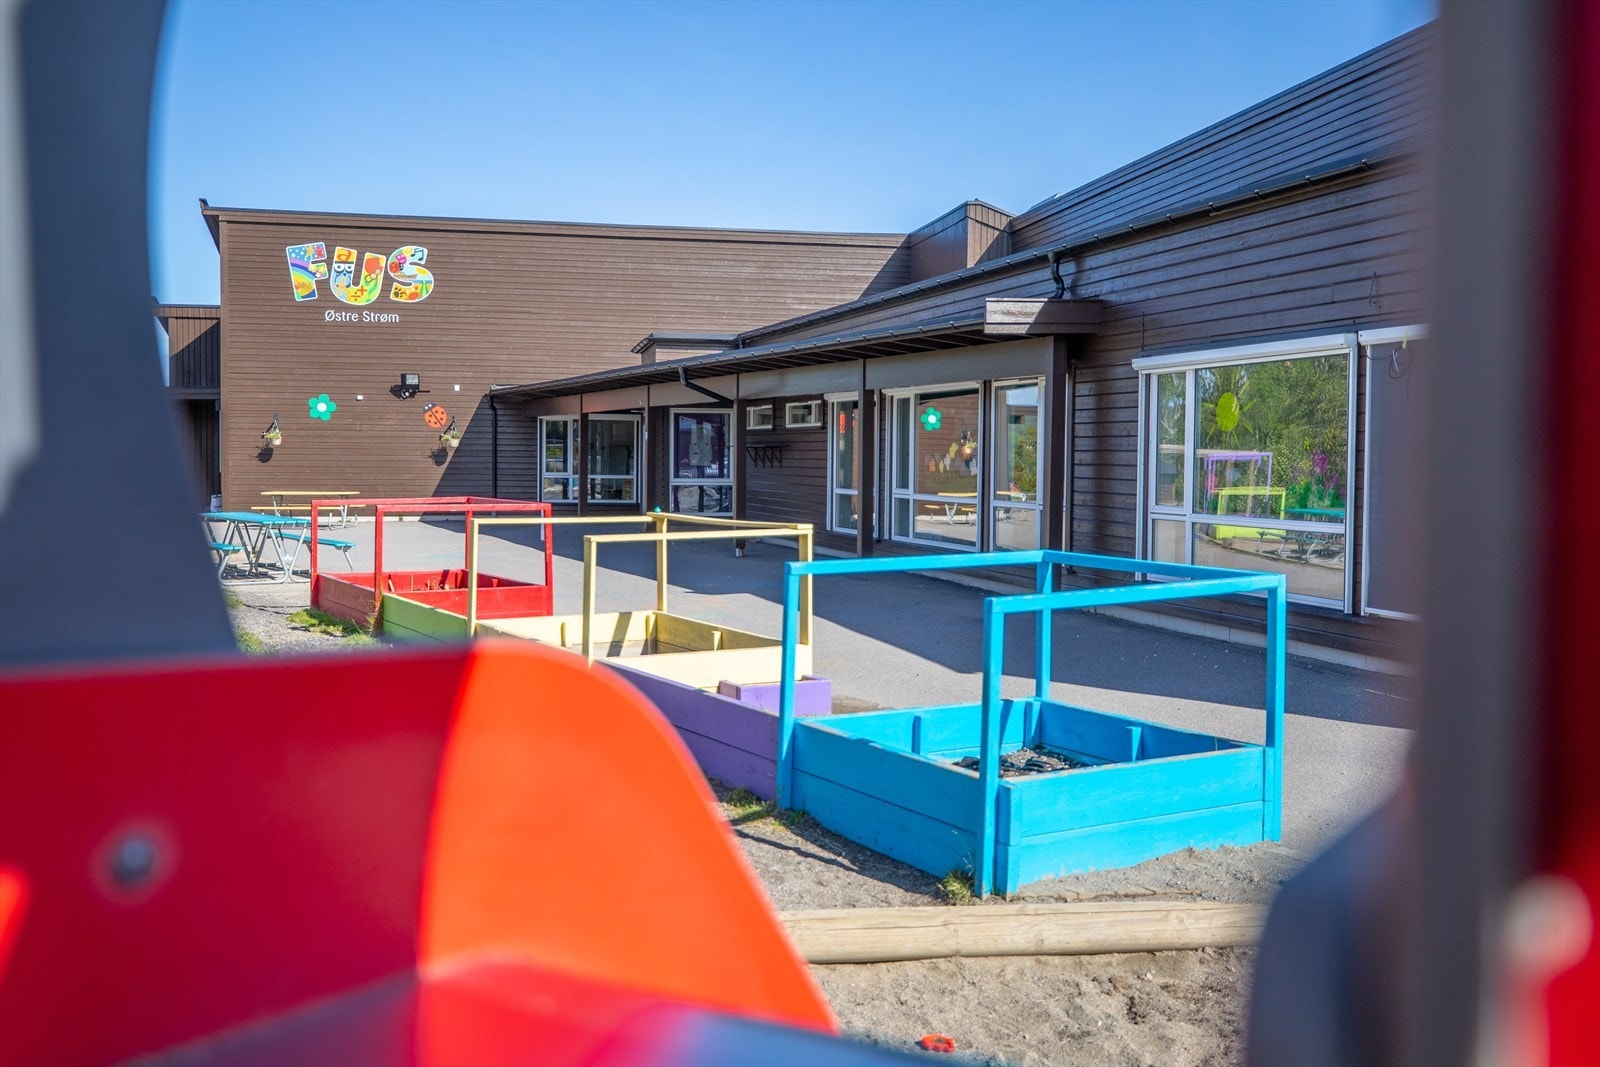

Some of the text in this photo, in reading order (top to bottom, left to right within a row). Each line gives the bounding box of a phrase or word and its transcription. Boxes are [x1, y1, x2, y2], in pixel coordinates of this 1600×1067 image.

[286, 242, 434, 305] FUS
[324, 310, 399, 323] Østre Strøm
